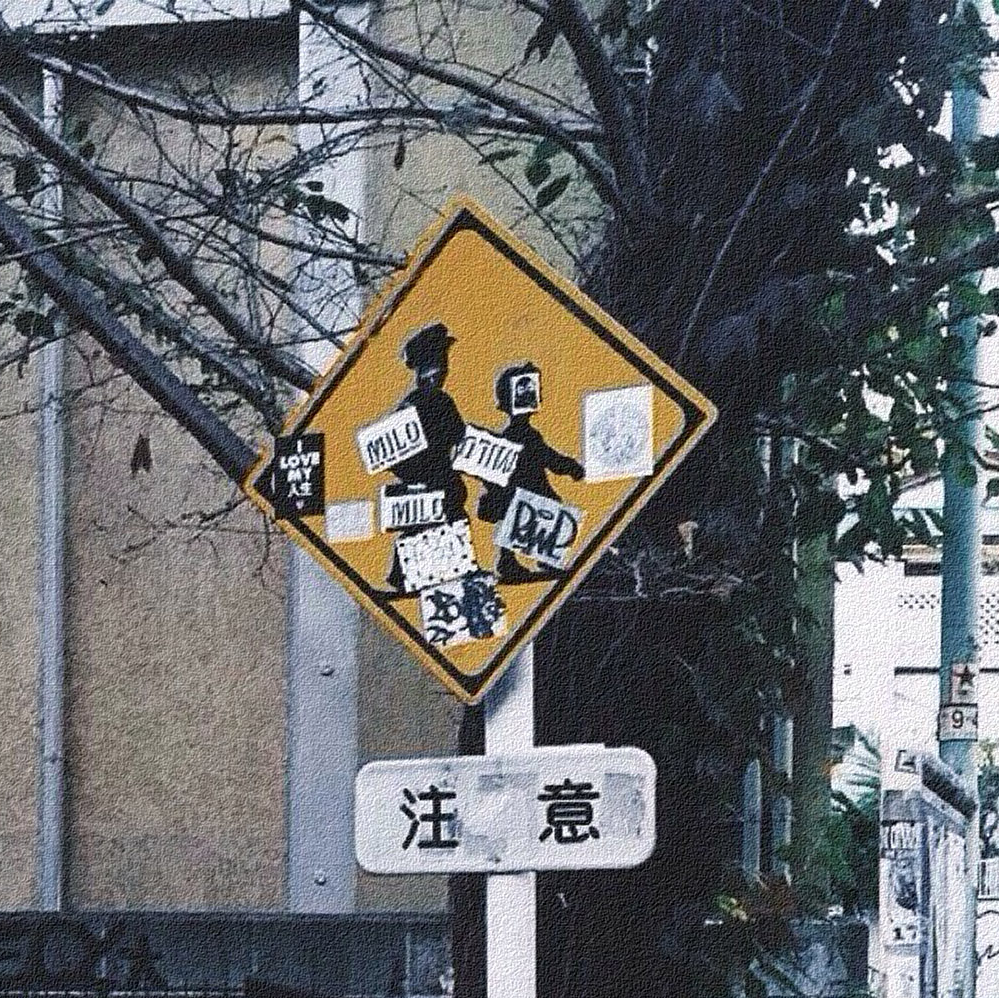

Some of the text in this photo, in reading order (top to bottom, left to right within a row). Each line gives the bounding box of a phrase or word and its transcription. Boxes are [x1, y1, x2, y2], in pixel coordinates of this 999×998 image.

[367, 420, 420, 464] MILO
[287, 465, 312, 482] MY
[391, 497, 444, 525] MILO
[399, 778, 601, 850] 注意
